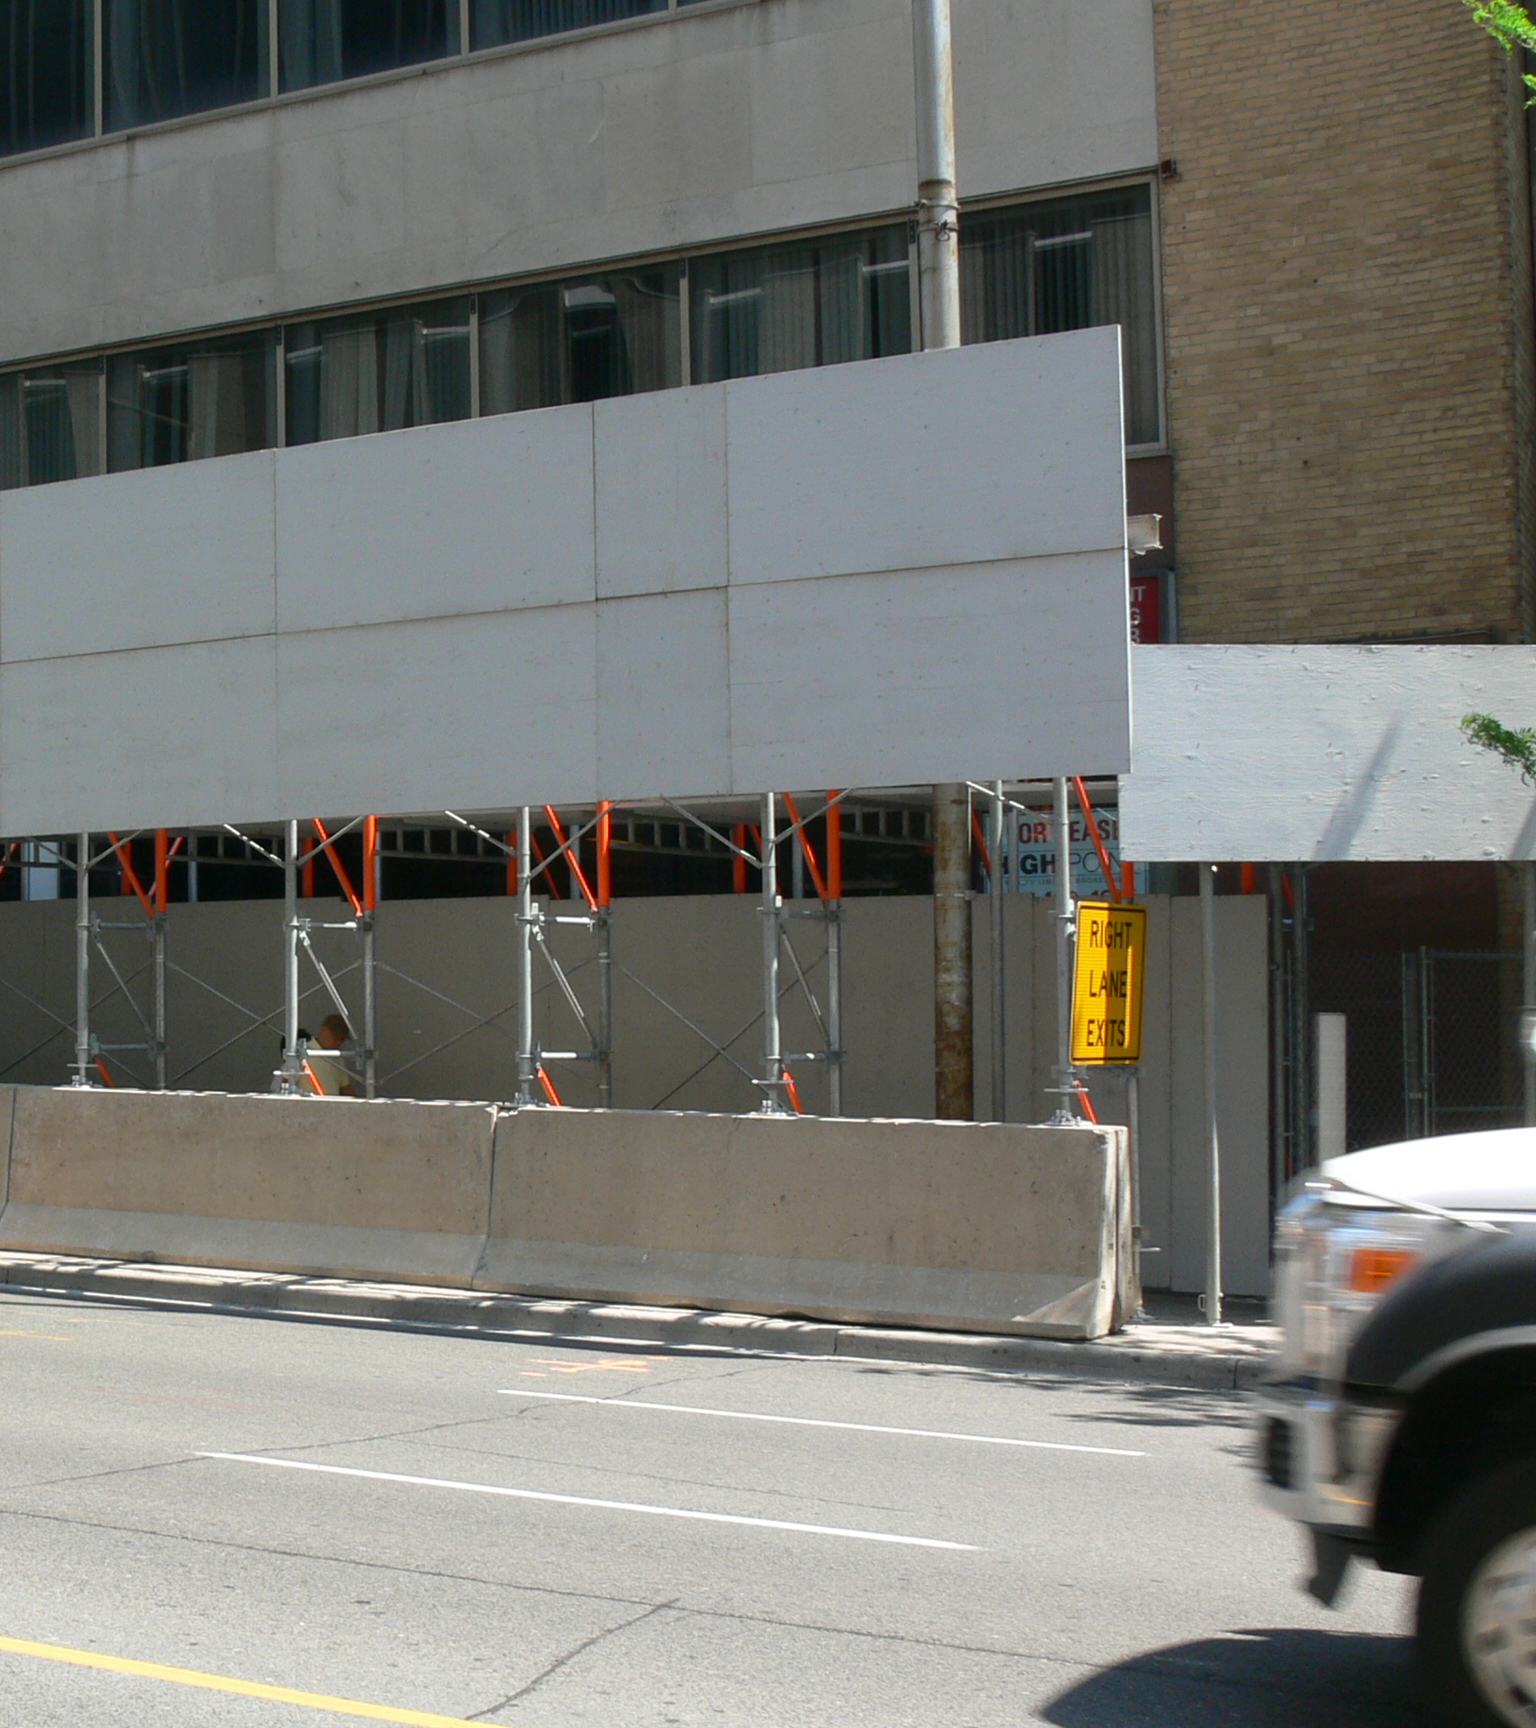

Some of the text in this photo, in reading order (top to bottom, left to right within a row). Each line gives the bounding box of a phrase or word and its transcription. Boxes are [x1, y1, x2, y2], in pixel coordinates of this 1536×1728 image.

[1018, 821, 1047, 844] OR
[1089, 920, 1133, 949] RIGHT
[1089, 969, 1128, 998] LANE
[1086, 1019, 1126, 1047] EXITS
